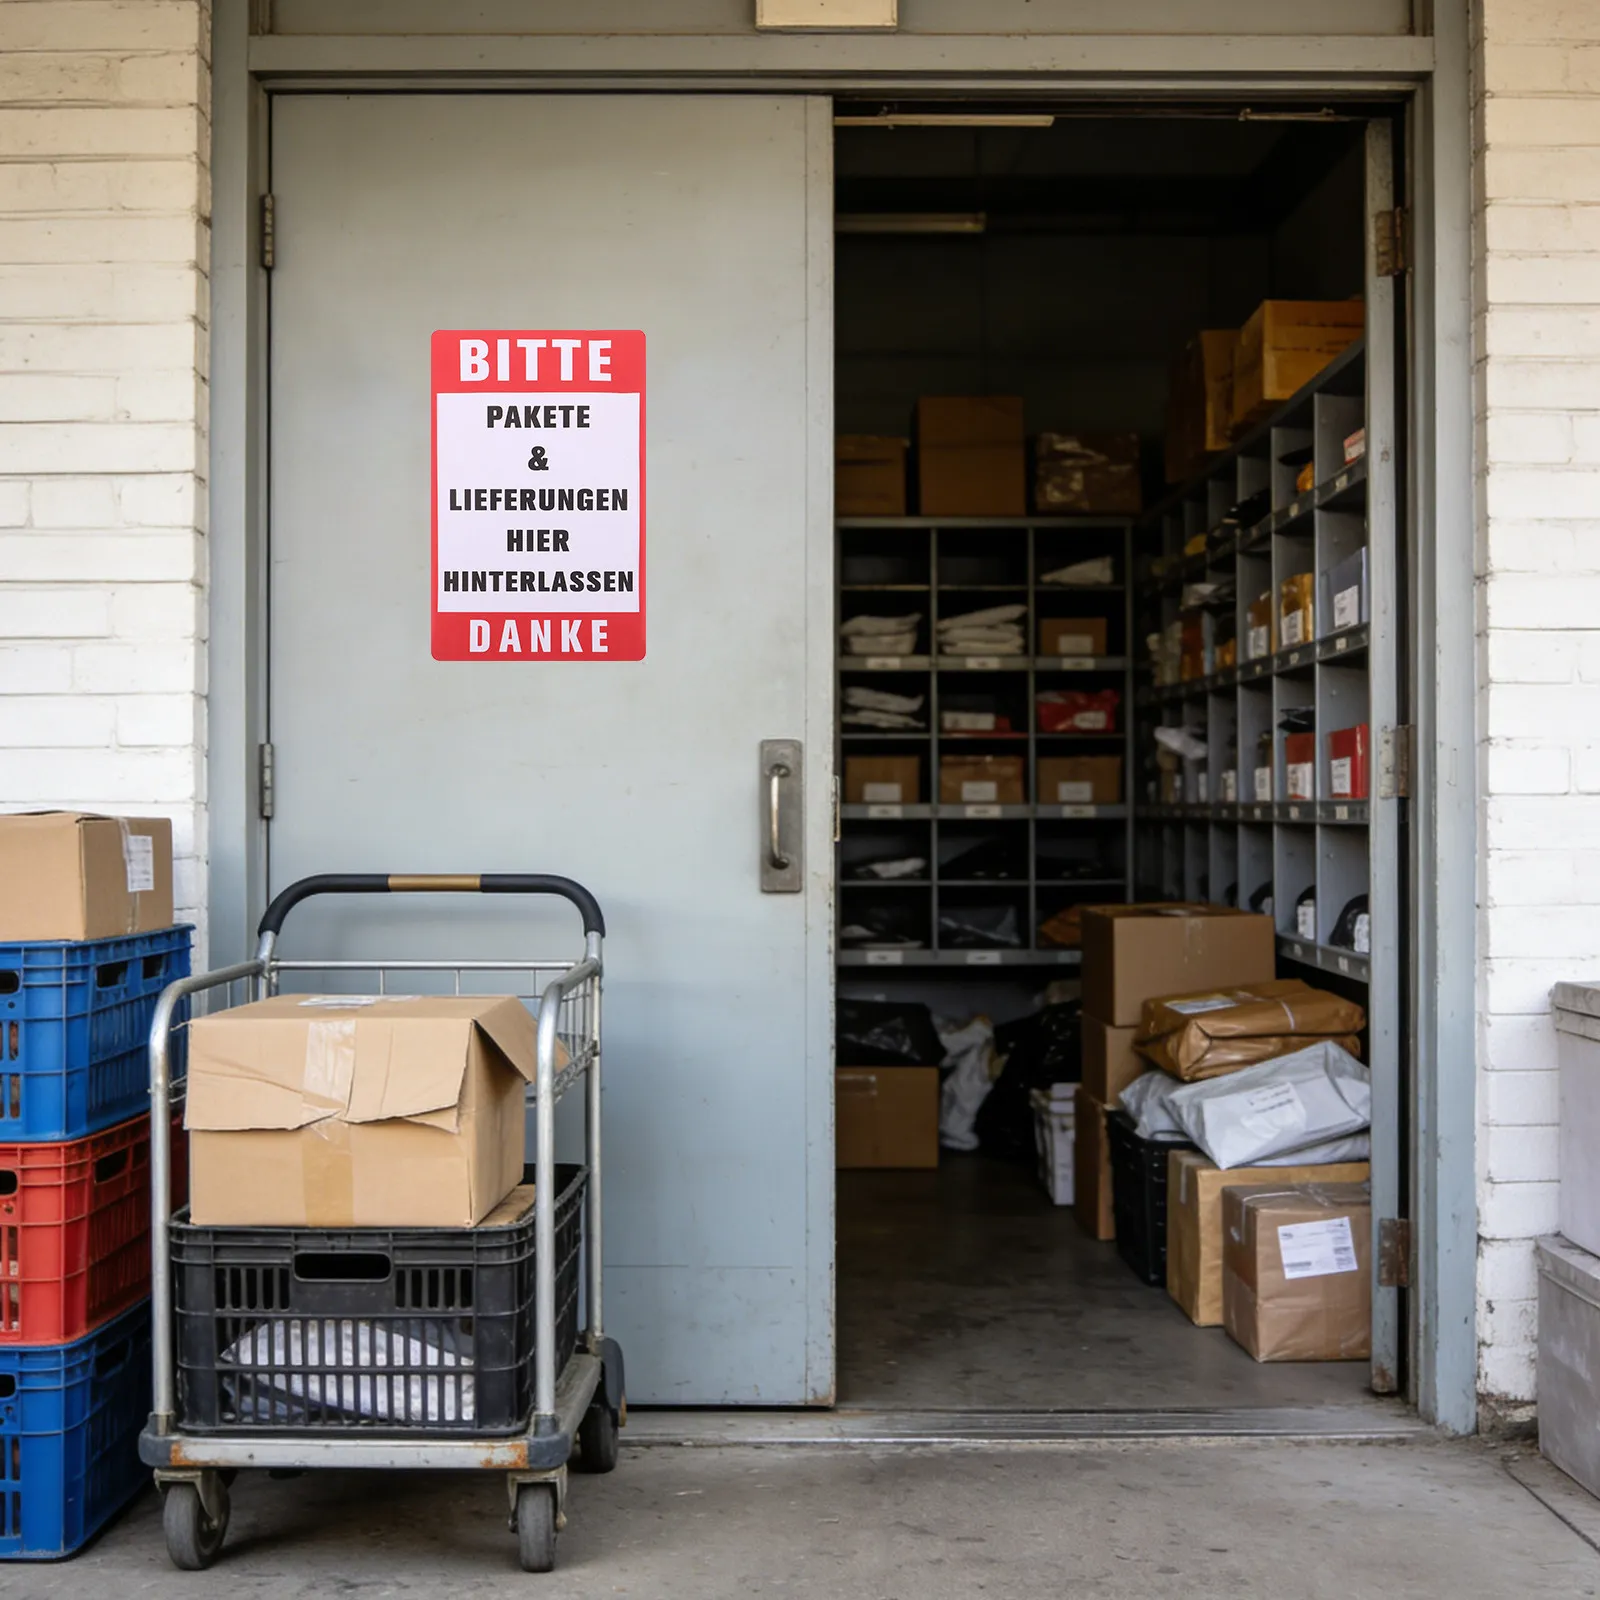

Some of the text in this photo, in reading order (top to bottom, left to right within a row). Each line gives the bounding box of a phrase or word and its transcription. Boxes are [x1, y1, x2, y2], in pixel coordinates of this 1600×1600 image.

[460, 339, 612, 382] BITTE
[486, 405, 590, 429] PAKETE
[527, 445, 549, 472] &
[449, 488, 628, 512] LIEFERUNGEN
[506, 529, 570, 552] HIER
[443, 570, 634, 593] HINTERLASSEN
[469, 619, 608, 653] DANKE
